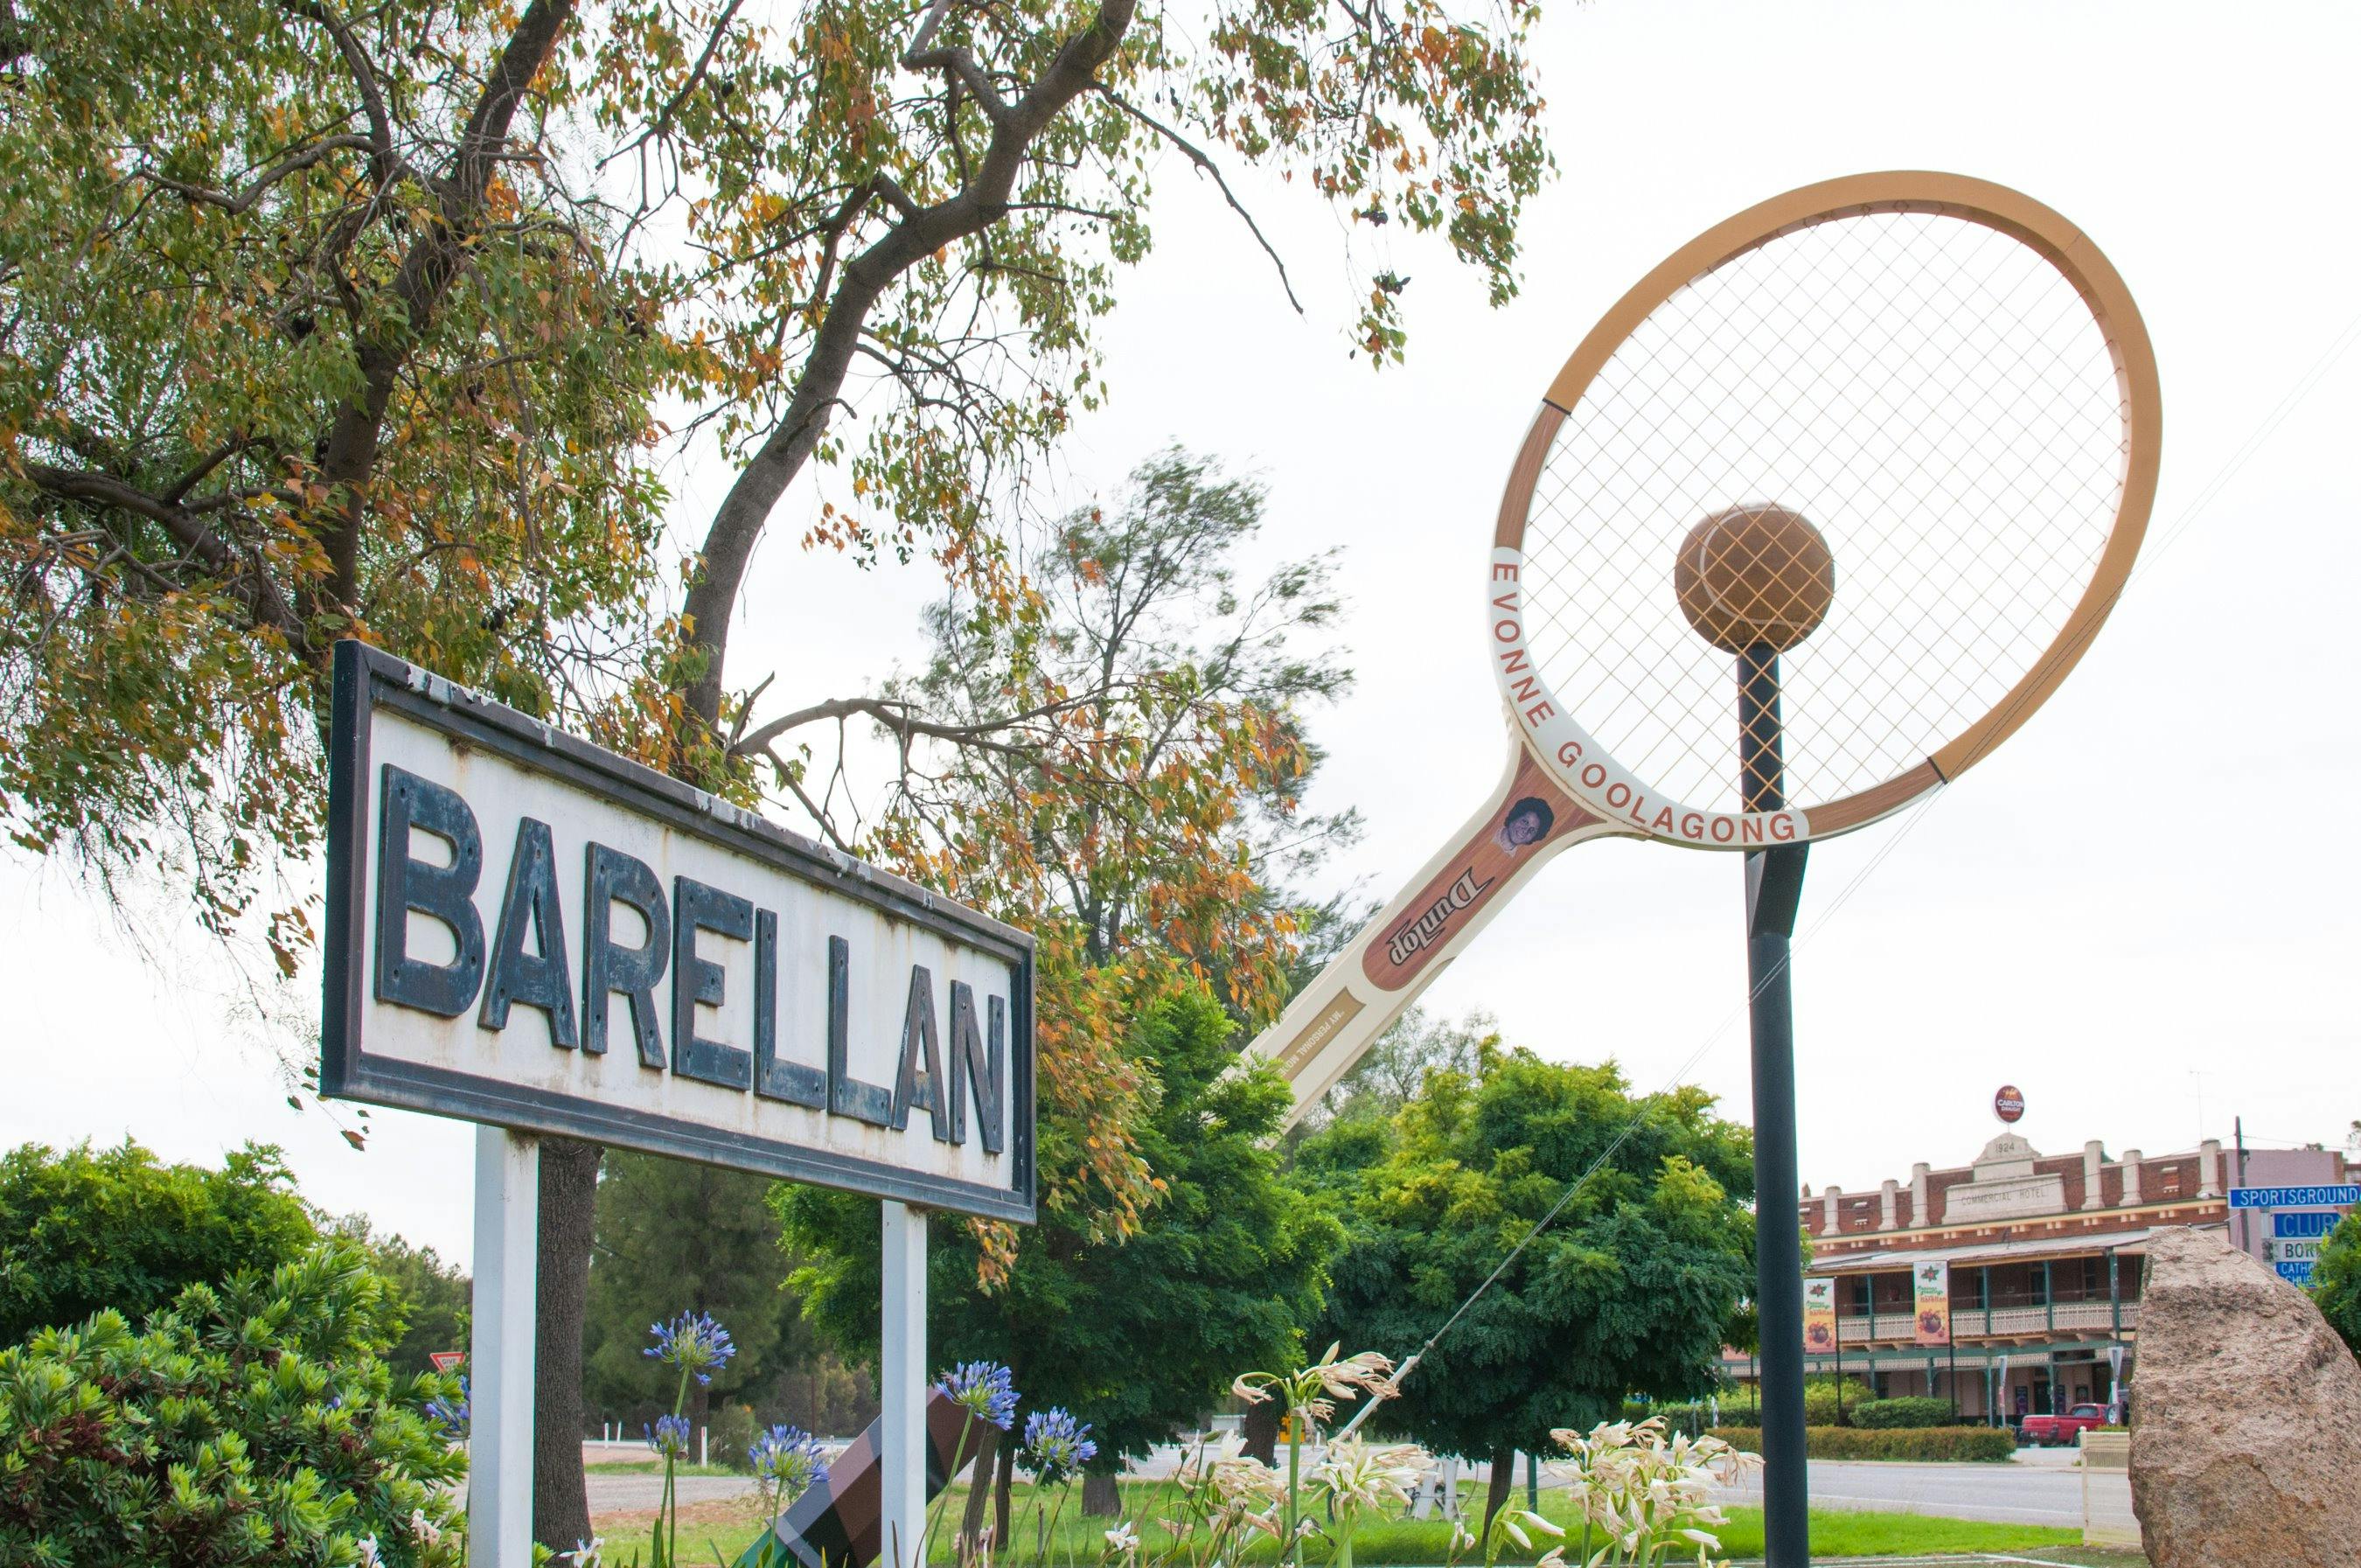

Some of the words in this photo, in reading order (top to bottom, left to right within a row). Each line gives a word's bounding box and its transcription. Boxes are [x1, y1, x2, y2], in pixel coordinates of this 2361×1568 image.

[1493, 562, 1555, 728] EVONNE
[1557, 741, 1796, 843] GOOLAGONG
[374, 763, 1005, 1155] BARELLAN
[1296, 1021, 1331, 1056] PERSONAL
[1995, 1143, 2015, 1153] 1924
[1961, 1192, 2011, 1206] COMMERCIAL
[2019, 1188, 2045, 1199] HOTEL
[2240, 1187, 2358, 1206] SPORTSGROUND
